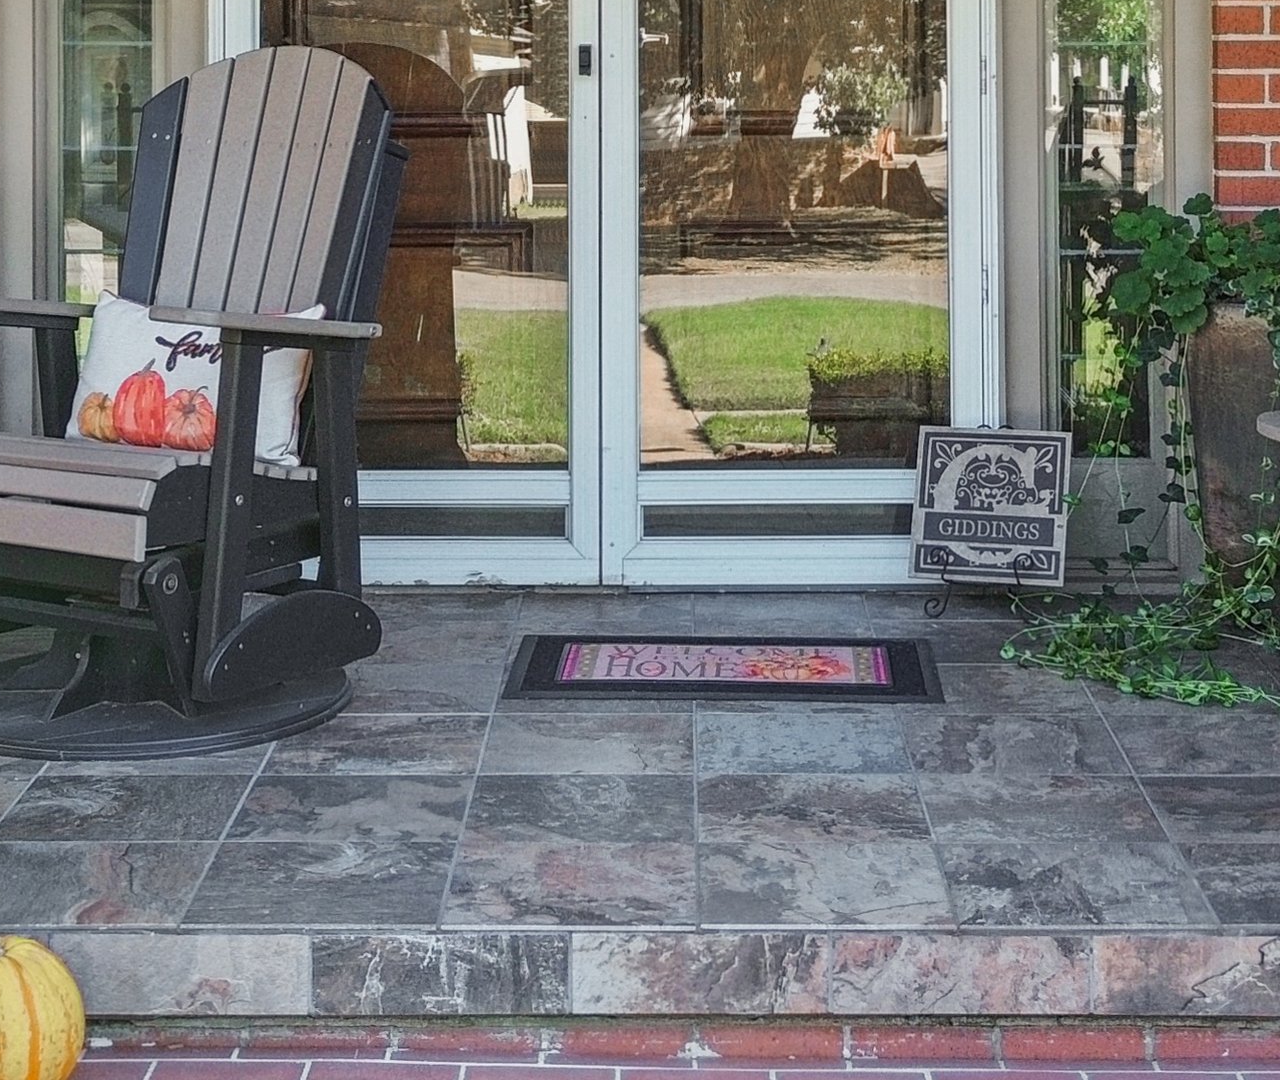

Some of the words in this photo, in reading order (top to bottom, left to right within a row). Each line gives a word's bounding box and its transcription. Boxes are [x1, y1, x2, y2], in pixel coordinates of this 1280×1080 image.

[938, 517, 1041, 541] GIDDINGS
[612, 644, 837, 657] WELCOME
[604, 655, 745, 679] HOME
